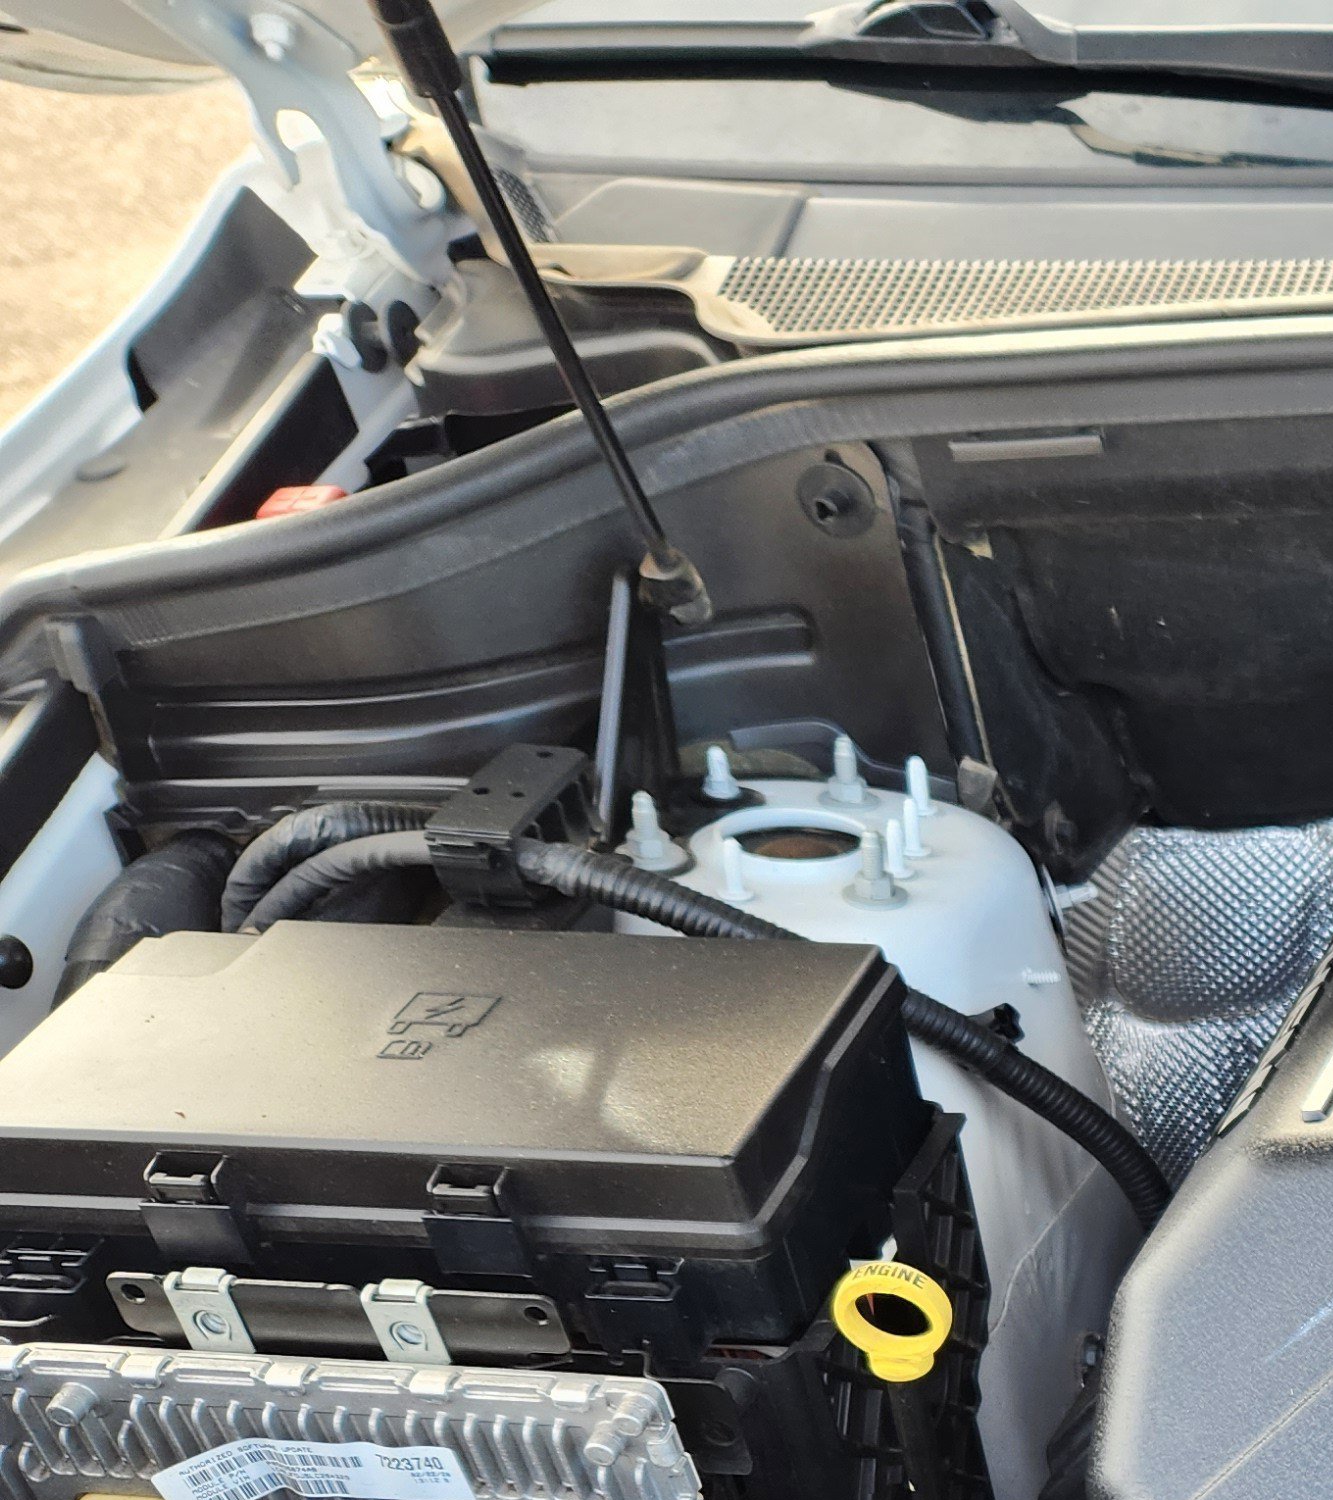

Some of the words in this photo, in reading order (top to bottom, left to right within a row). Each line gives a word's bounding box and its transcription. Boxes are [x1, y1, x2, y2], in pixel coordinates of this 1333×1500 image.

[852, 1264, 928, 1290] ENGINE
[178, 1450, 233, 1476] AUTHORIZED
[281, 1446, 314, 1454] UPDATE
[375, 1453, 445, 1472] 7223740
[192, 1477, 225, 1495] MODULE
[196, 1484, 230, 1500] MODULE
[233, 1475, 251, 1486] VIN
